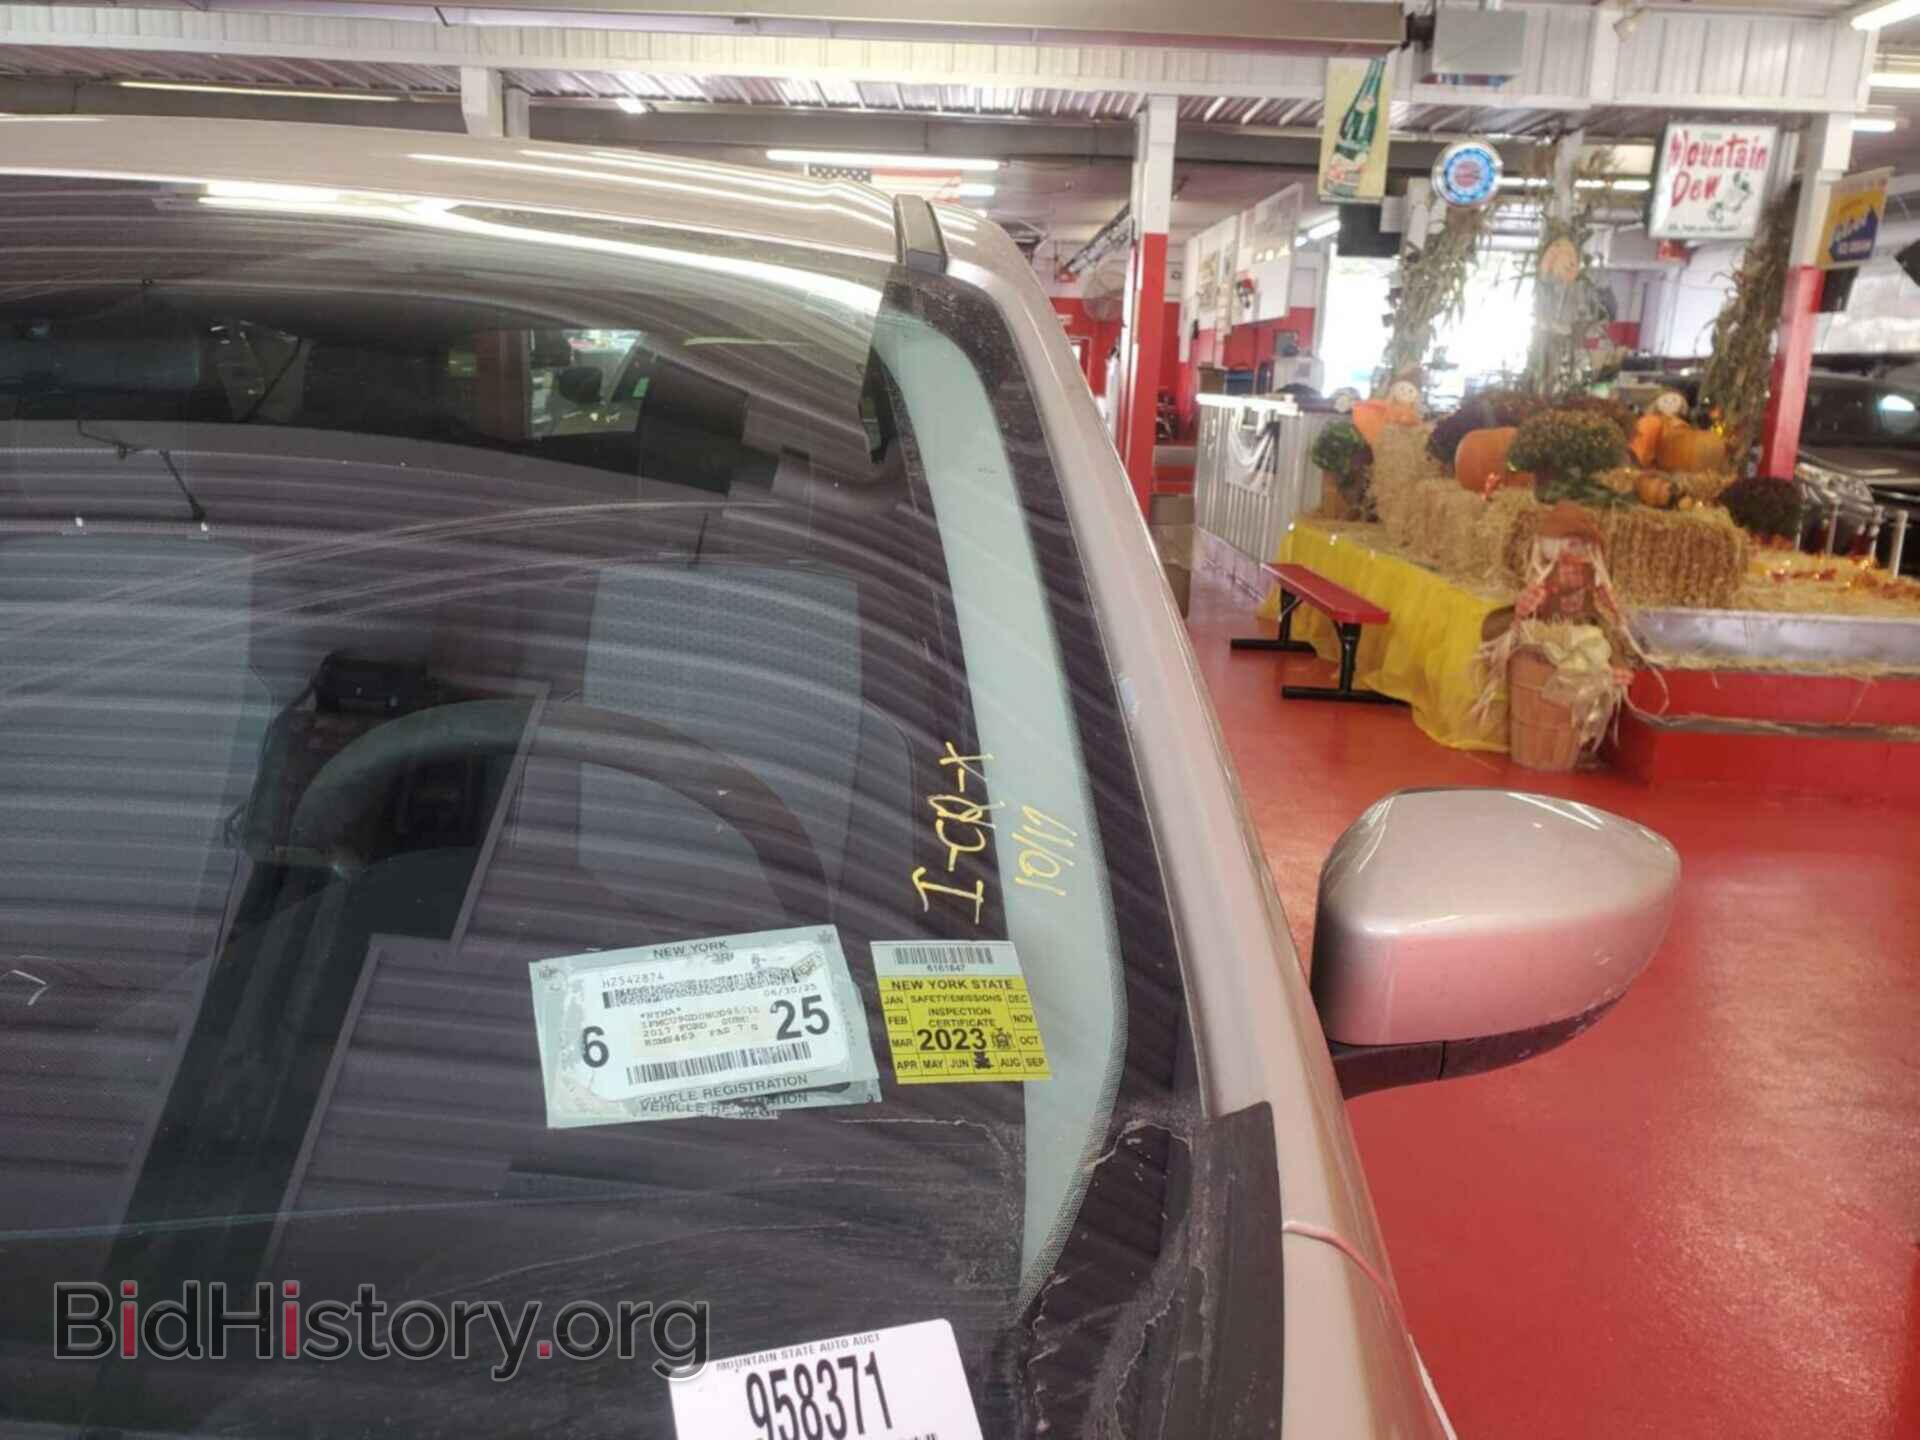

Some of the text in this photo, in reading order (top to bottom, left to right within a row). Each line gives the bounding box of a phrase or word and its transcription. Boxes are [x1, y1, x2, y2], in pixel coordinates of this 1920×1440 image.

[1667, 130, 1768, 172] Mountain
[1671, 171, 1723, 208] Dew
[653, 940, 729, 960] NEW YORK
[891, 979, 1013, 990] NEW YORK STATE
[884, 995, 904, 1005] JAN
[1008, 994, 1028, 1004] DEC
[928, 1007, 991, 1016] INSPECTION
[770, 995, 830, 1041] 25
[888, 1015, 908, 1025] FEB
[928, 1018, 996, 1028] CERTIFICATE
[1013, 1014, 1033, 1023] NOV
[892, 1038, 913, 1048] MAR
[916, 1028, 987, 1051] 2023
[1020, 1036, 1039, 1045] OCT
[582, 1026, 610, 1068] 6
[896, 1061, 918, 1071] APR
[922, 1060, 943, 1069] MAY
[951, 1060, 969, 1069] JUN
[1001, 1060, 1021, 1069] AUG
[1025, 1058, 1045, 1067] SEP
[703, 1074, 808, 1100] REGISTRATION
[640, 1100, 705, 1113] VEHICLE
[716, 1333, 881, 1371] MOUNTAIN STATE AUTO AUCT
[746, 1351, 893, 1440] 958371
